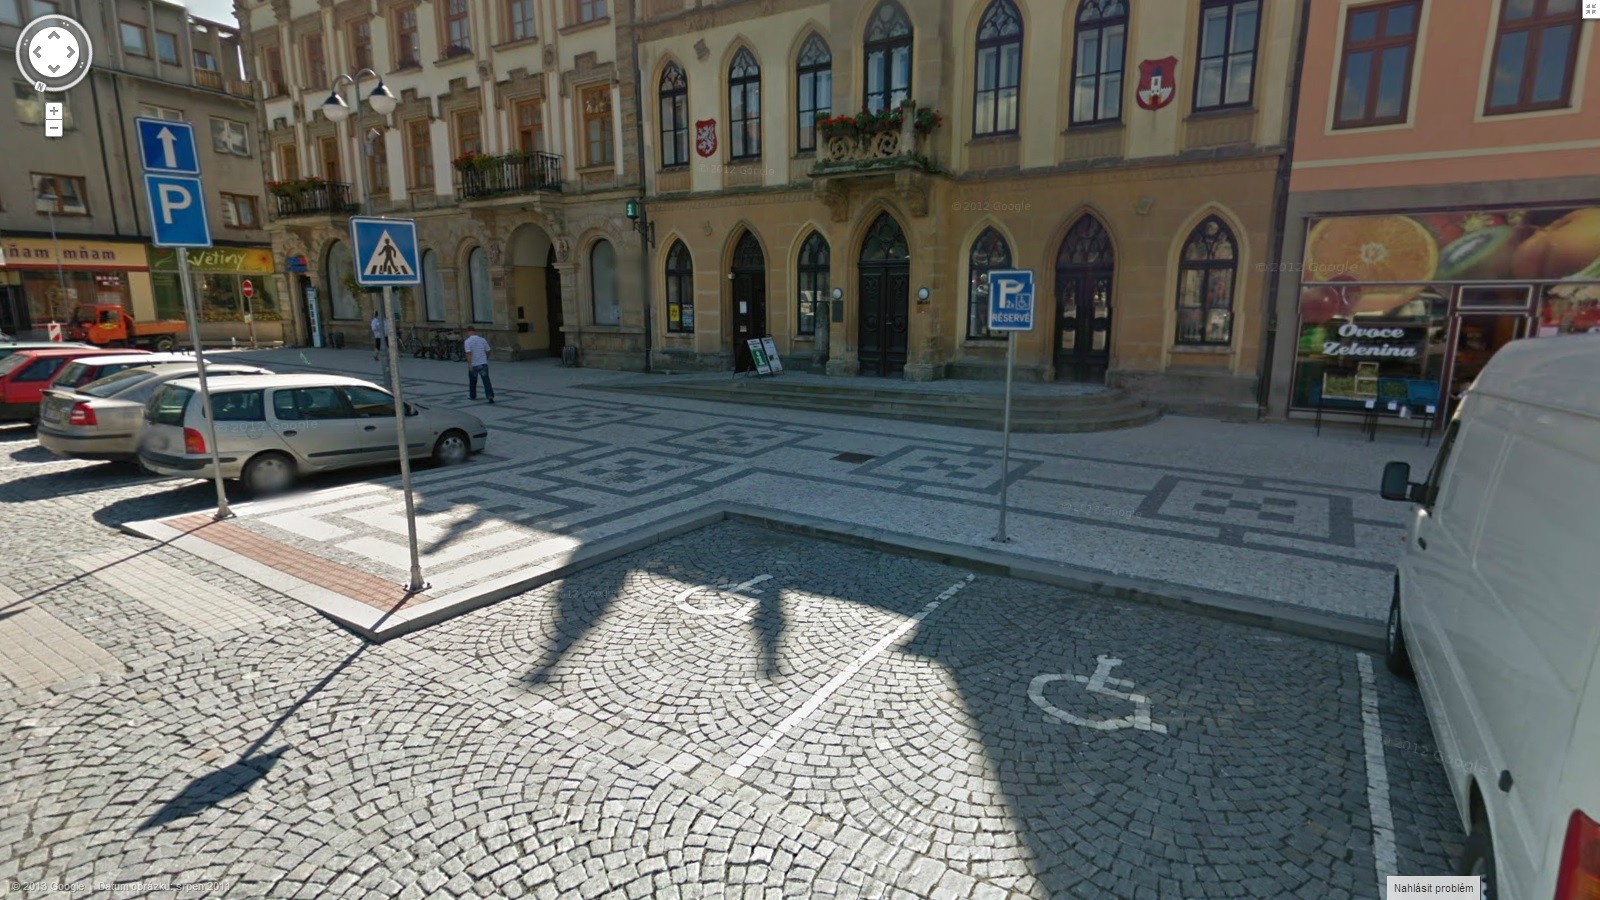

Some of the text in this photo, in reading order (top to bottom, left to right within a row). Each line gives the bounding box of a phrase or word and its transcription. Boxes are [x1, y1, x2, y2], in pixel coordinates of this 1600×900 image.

[158, 183, 192, 224] P
[4, 244, 115, 260] ňam mňam
[998, 279, 1026, 309] P
[1338, 323, 1405, 338] Ovoce
[1322, 341, 1418, 358] Zelenina
